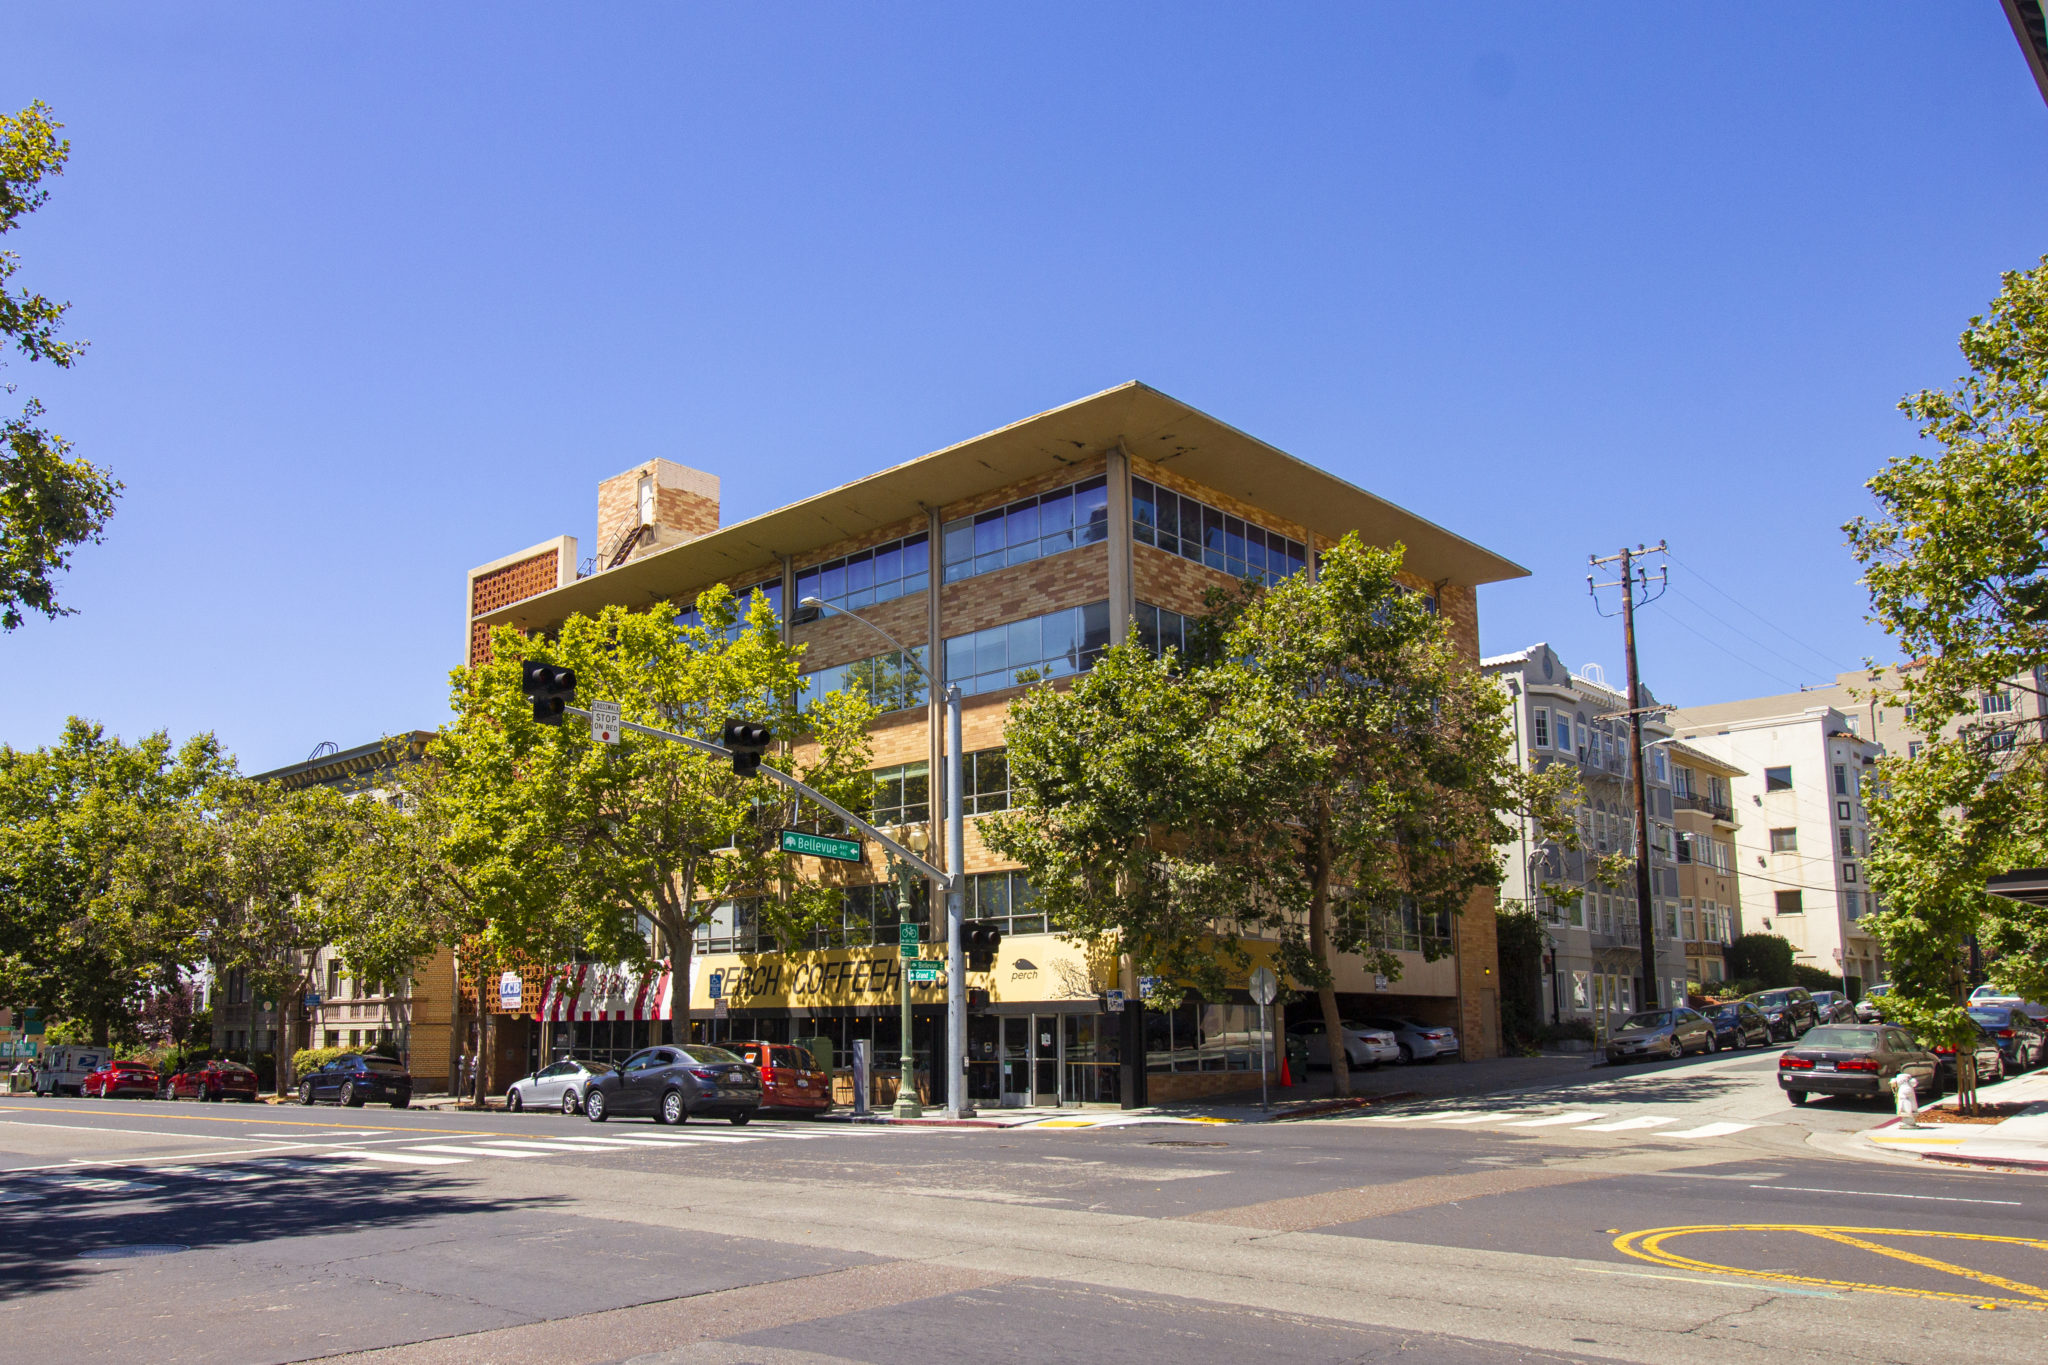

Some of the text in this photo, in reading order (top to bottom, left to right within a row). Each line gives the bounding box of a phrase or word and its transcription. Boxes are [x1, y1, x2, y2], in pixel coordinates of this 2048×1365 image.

[596, 713, 617, 723] STOP
[594, 722, 618, 732] ON RED
[797, 837, 838, 854] Bellevue
[915, 971, 929, 979] Grand
[1010, 970, 1038, 983] perch
[502, 982, 521, 995] LCB
